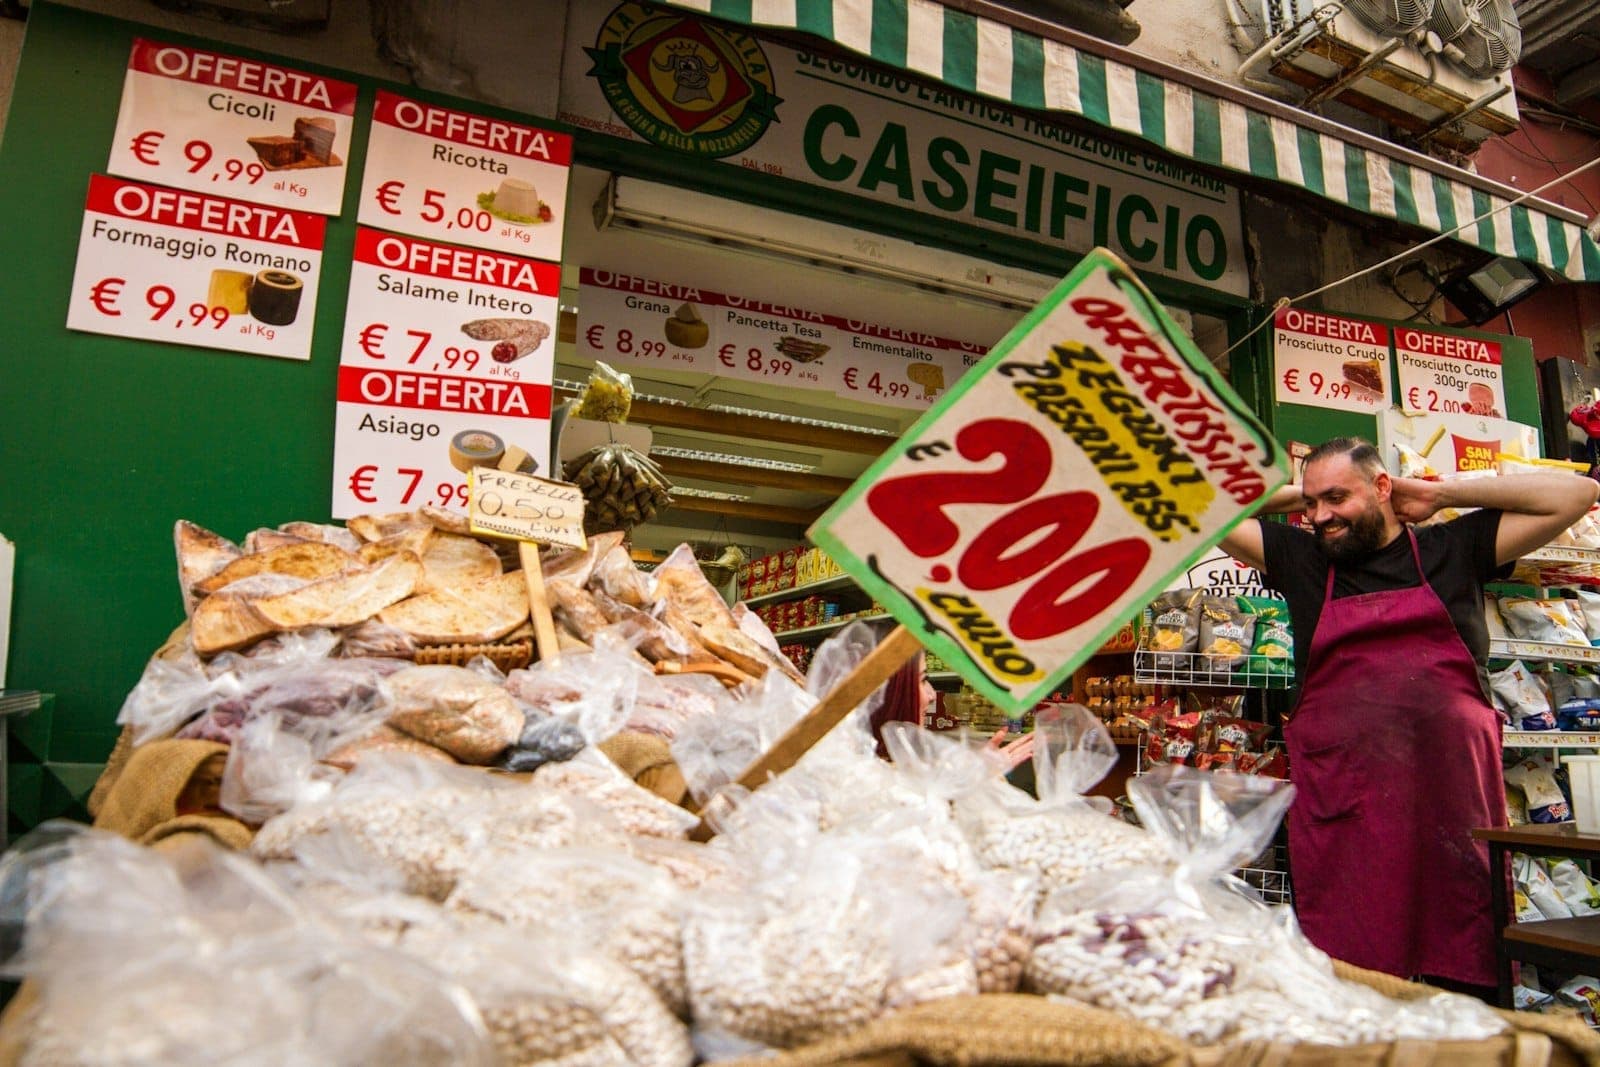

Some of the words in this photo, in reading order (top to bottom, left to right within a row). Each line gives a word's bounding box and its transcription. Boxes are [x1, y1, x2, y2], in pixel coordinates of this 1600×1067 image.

[155, 48, 333, 108] OFFERTA
[207, 93, 275, 121] Cicoli
[395, 100, 550, 159] OFFERTA
[658, 128, 696, 152] DELLA
[130, 131, 164, 166] €
[184, 140, 265, 185] 9,99
[274, 181, 285, 192] al
[290, 183, 308, 198] Kg
[432, 144, 508, 175] Ricotta
[742, 157, 761, 173] DAL
[803, 104, 1227, 281] CASEIFICIO
[114, 186, 300, 244] OFFERTA
[375, 180, 405, 215] €
[420, 189, 493, 232] 5,00
[501, 228, 511, 237] al
[515, 230, 531, 243] Kg
[92, 219, 217, 260] Formaggio
[225, 243, 312, 273] Romano
[376, 238, 539, 292] OFFERTA
[89, 278, 125, 316] €
[145, 285, 230, 330] 9,99
[240, 324, 251, 334] al
[256, 326, 275, 341] Kg
[377, 274, 459, 303] Salame
[468, 289, 533, 315] Intero
[625, 295, 671, 314] Grana
[586, 324, 605, 349] €
[616, 329, 666, 357] 8,99
[726, 310, 788, 333] Pancetta
[792, 322, 823, 339] Tesa
[1285, 310, 1377, 343] OFFERTA
[359, 324, 389, 359] €
[406, 330, 480, 371] 7,99
[489, 366, 499, 376] al
[503, 368, 520, 380] Kg
[718, 343, 736, 368] €
[747, 348, 793, 376] 8,99
[852, 336, 933, 361] Emmentalito
[1278, 333, 1343, 355] Prosciutto
[1346, 344, 1386, 362] Crudo
[1404, 332, 1492, 361] OFFERTA
[1402, 353, 1462, 374] Prosciutto
[1464, 363, 1498, 379] Cotto
[1434, 373, 1469, 391] 300gr
[360, 372, 530, 415] OFFERTA
[844, 367, 859, 390] €
[867, 372, 910, 398] 4,99
[1283, 368, 1301, 393] €
[1308, 371, 1351, 400] 9,99
[1408, 386, 1422, 410] €
[1069, 296, 1267, 505] OFFERTISSIMA
[358, 413, 441, 441] Asiago
[1459, 459, 1500, 472] CARLO
[1466, 446, 1493, 460] SAN
[349, 465, 379, 503] €
